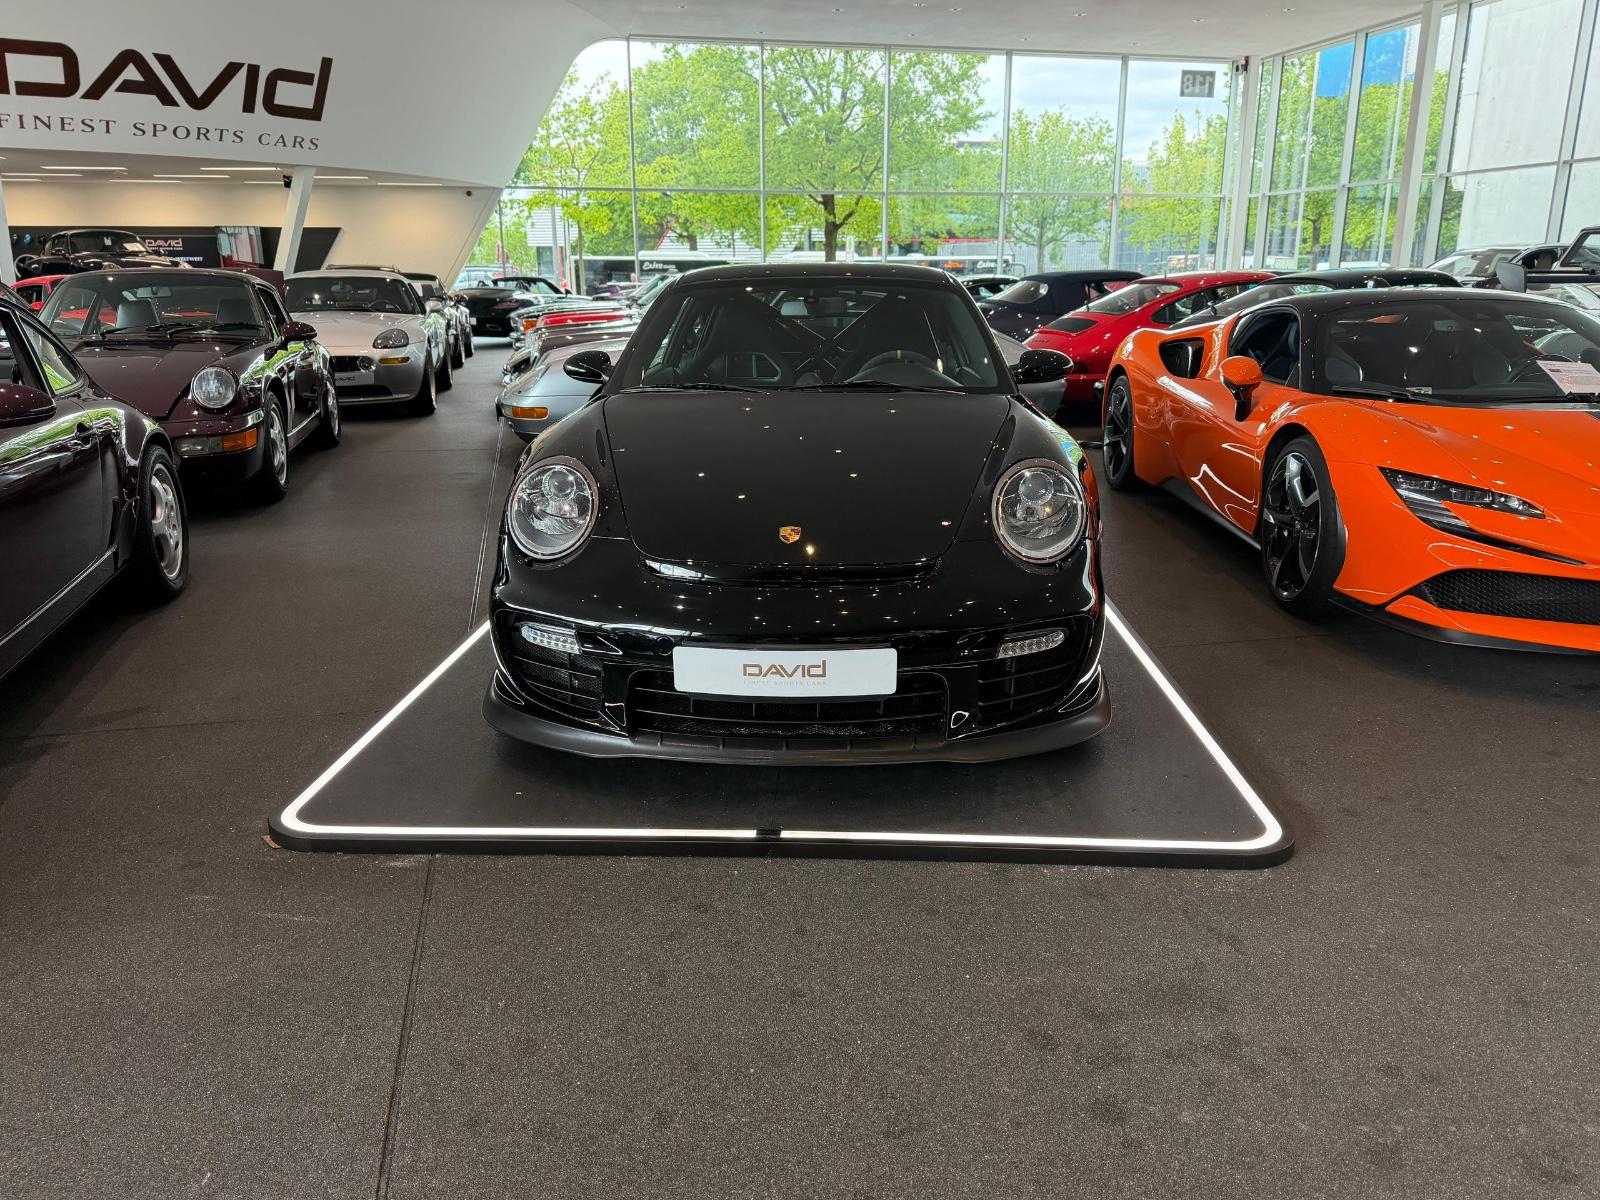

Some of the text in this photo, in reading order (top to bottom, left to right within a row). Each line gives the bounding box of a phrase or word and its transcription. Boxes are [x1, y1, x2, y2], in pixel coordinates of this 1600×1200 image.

[0, 113, 320, 152] FINEST SPORTS CARS
